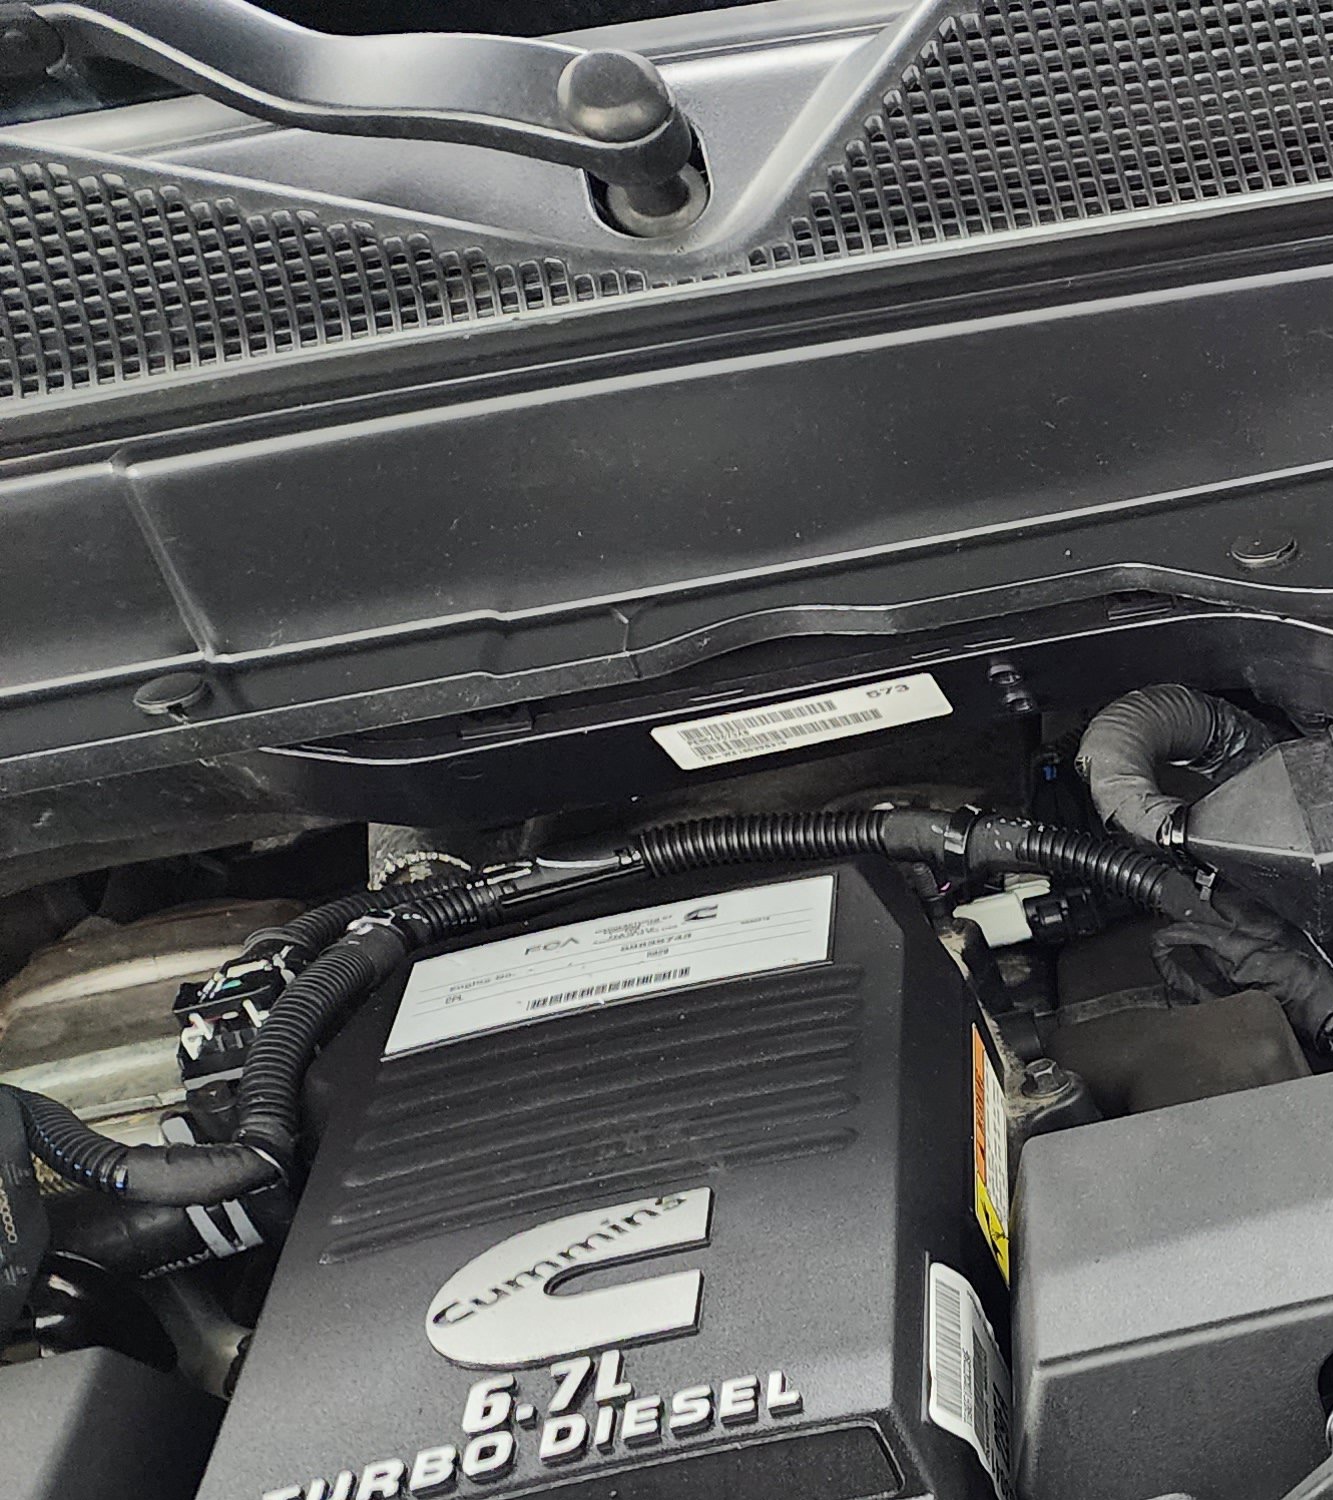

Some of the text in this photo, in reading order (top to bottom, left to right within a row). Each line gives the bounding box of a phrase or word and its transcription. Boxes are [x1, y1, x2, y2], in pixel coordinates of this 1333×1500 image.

[866, 684, 910, 699] 573
[524, 936, 580, 956] FCA
[462, 1350, 633, 1436] 6.7L
[539, 1371, 803, 1465] DIESEL
